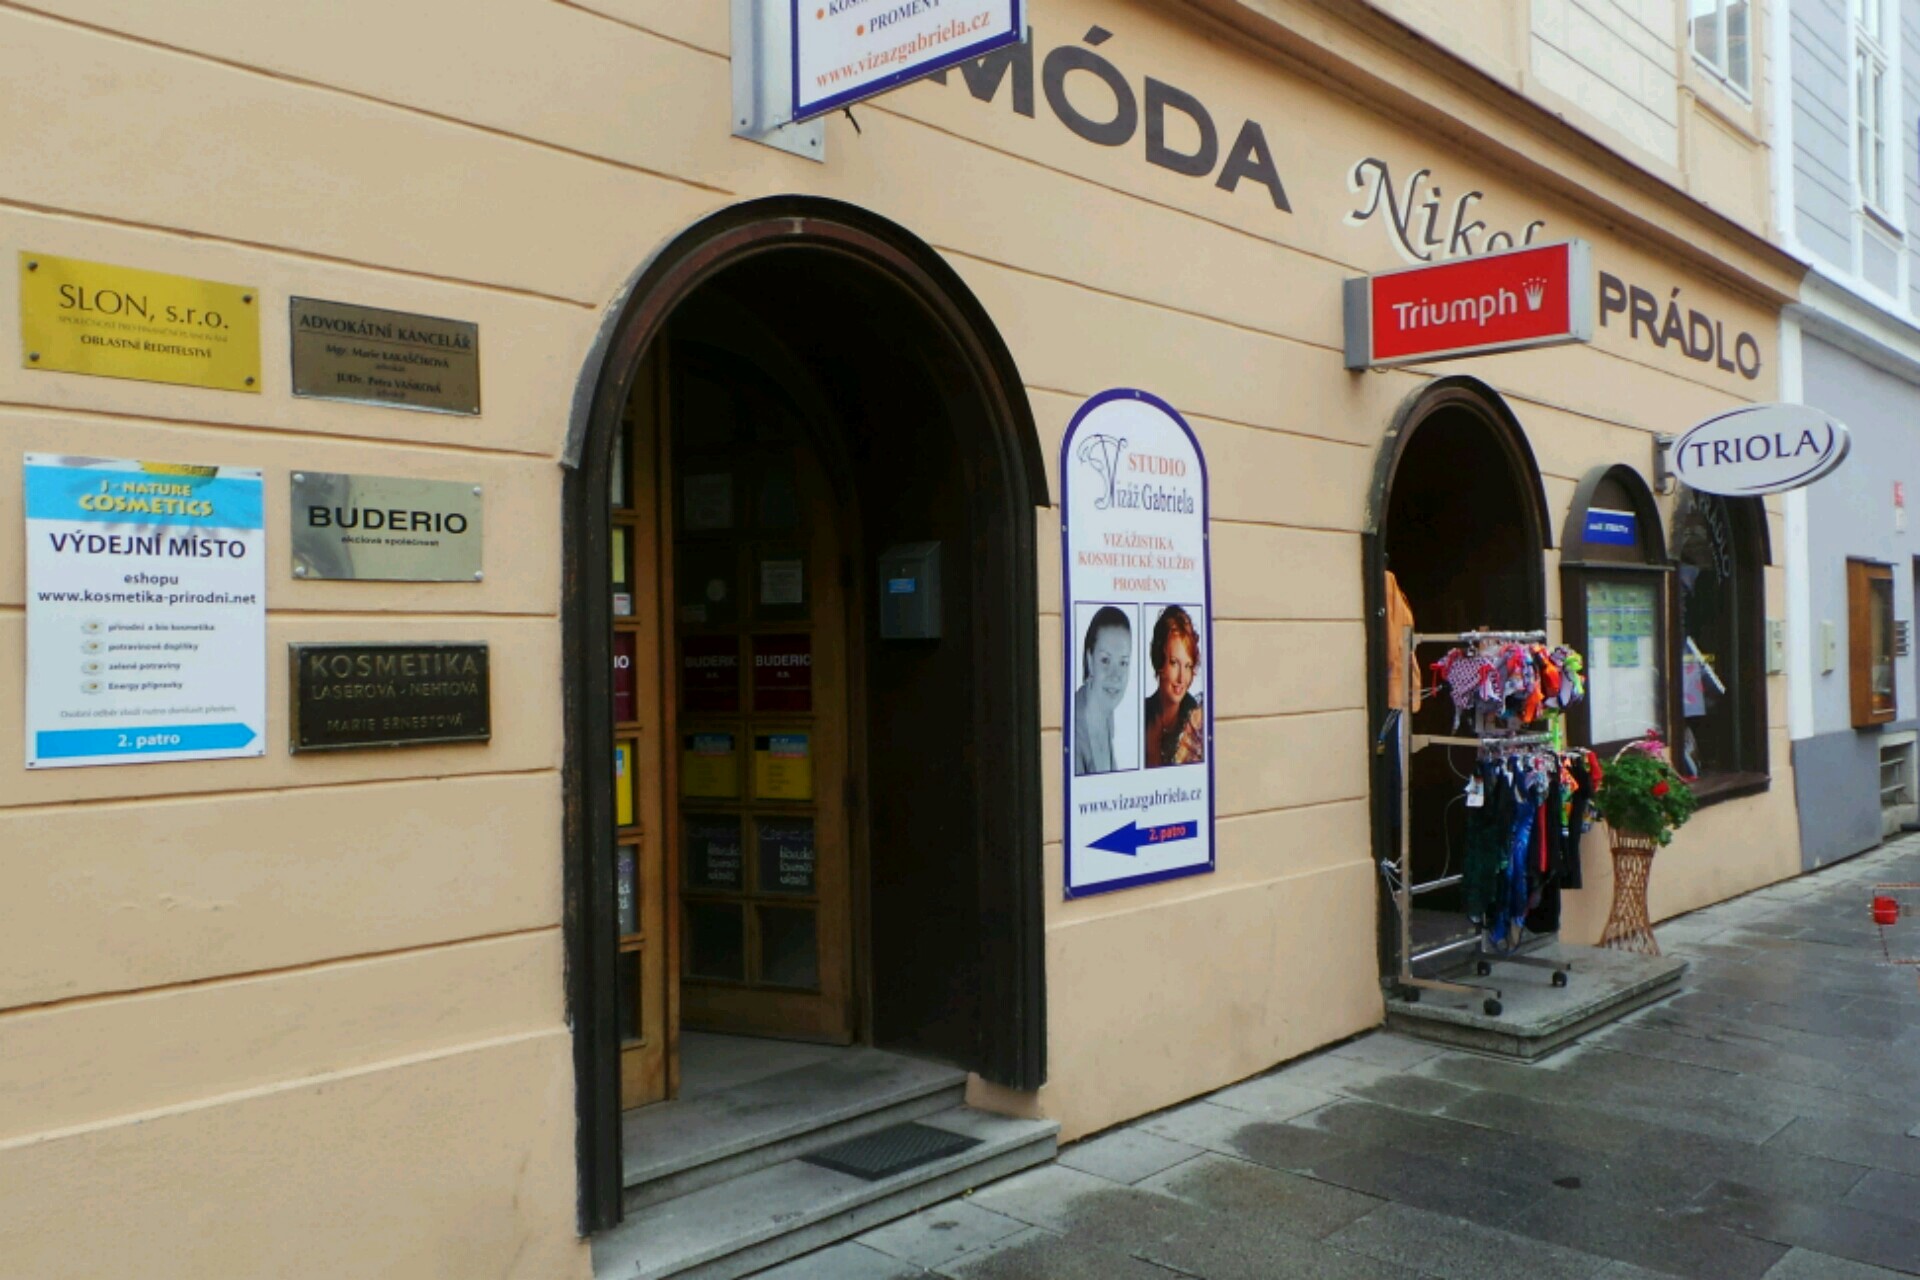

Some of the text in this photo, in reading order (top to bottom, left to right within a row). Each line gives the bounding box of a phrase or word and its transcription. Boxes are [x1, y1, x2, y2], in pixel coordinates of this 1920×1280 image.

[816, 11, 990, 87] www.vizazgabriela.cz
[921, 24, 1292, 214] MÓDA
[59, 284, 230, 329] SLON, s.r.o.
[1392, 288, 1518, 330] Triumph
[300, 313, 472, 349] ADVOKÁTNÍ KANCELÁŘ
[1599, 270, 1762, 380] PRÁDLO
[1691, 430, 1820, 467] TRIOLA
[1129, 453, 1187, 477] STUDIO
[123, 481, 192, 497] NATURE
[1143, 484, 1195, 514] Gabriela
[79, 494, 214, 517] COSMETICS
[308, 505, 468, 534] BUDERIO
[50, 530, 246, 559] VÝDEJNÍ MÍSTO
[1104, 531, 1175, 551] VIZÁŽISTIKA
[1078, 551, 1195, 571] KOSMETICKÉ SLUŽBY
[124, 572, 178, 586] eshopu
[38, 589, 256, 606] www.kosmetika-prirodni.net
[310, 653, 479, 679] KOSMETIKA
[312, 679, 397, 700] LASEROVÁ
[409, 679, 479, 697] NEHTOVÁ
[327, 713, 463, 732] MARIE ERNESTOVÁ
[117, 733, 181, 749] 2. patro
[1078, 787, 1202, 815] www.vizazgabriela.cz
[1160, 825, 1186, 843] patro
